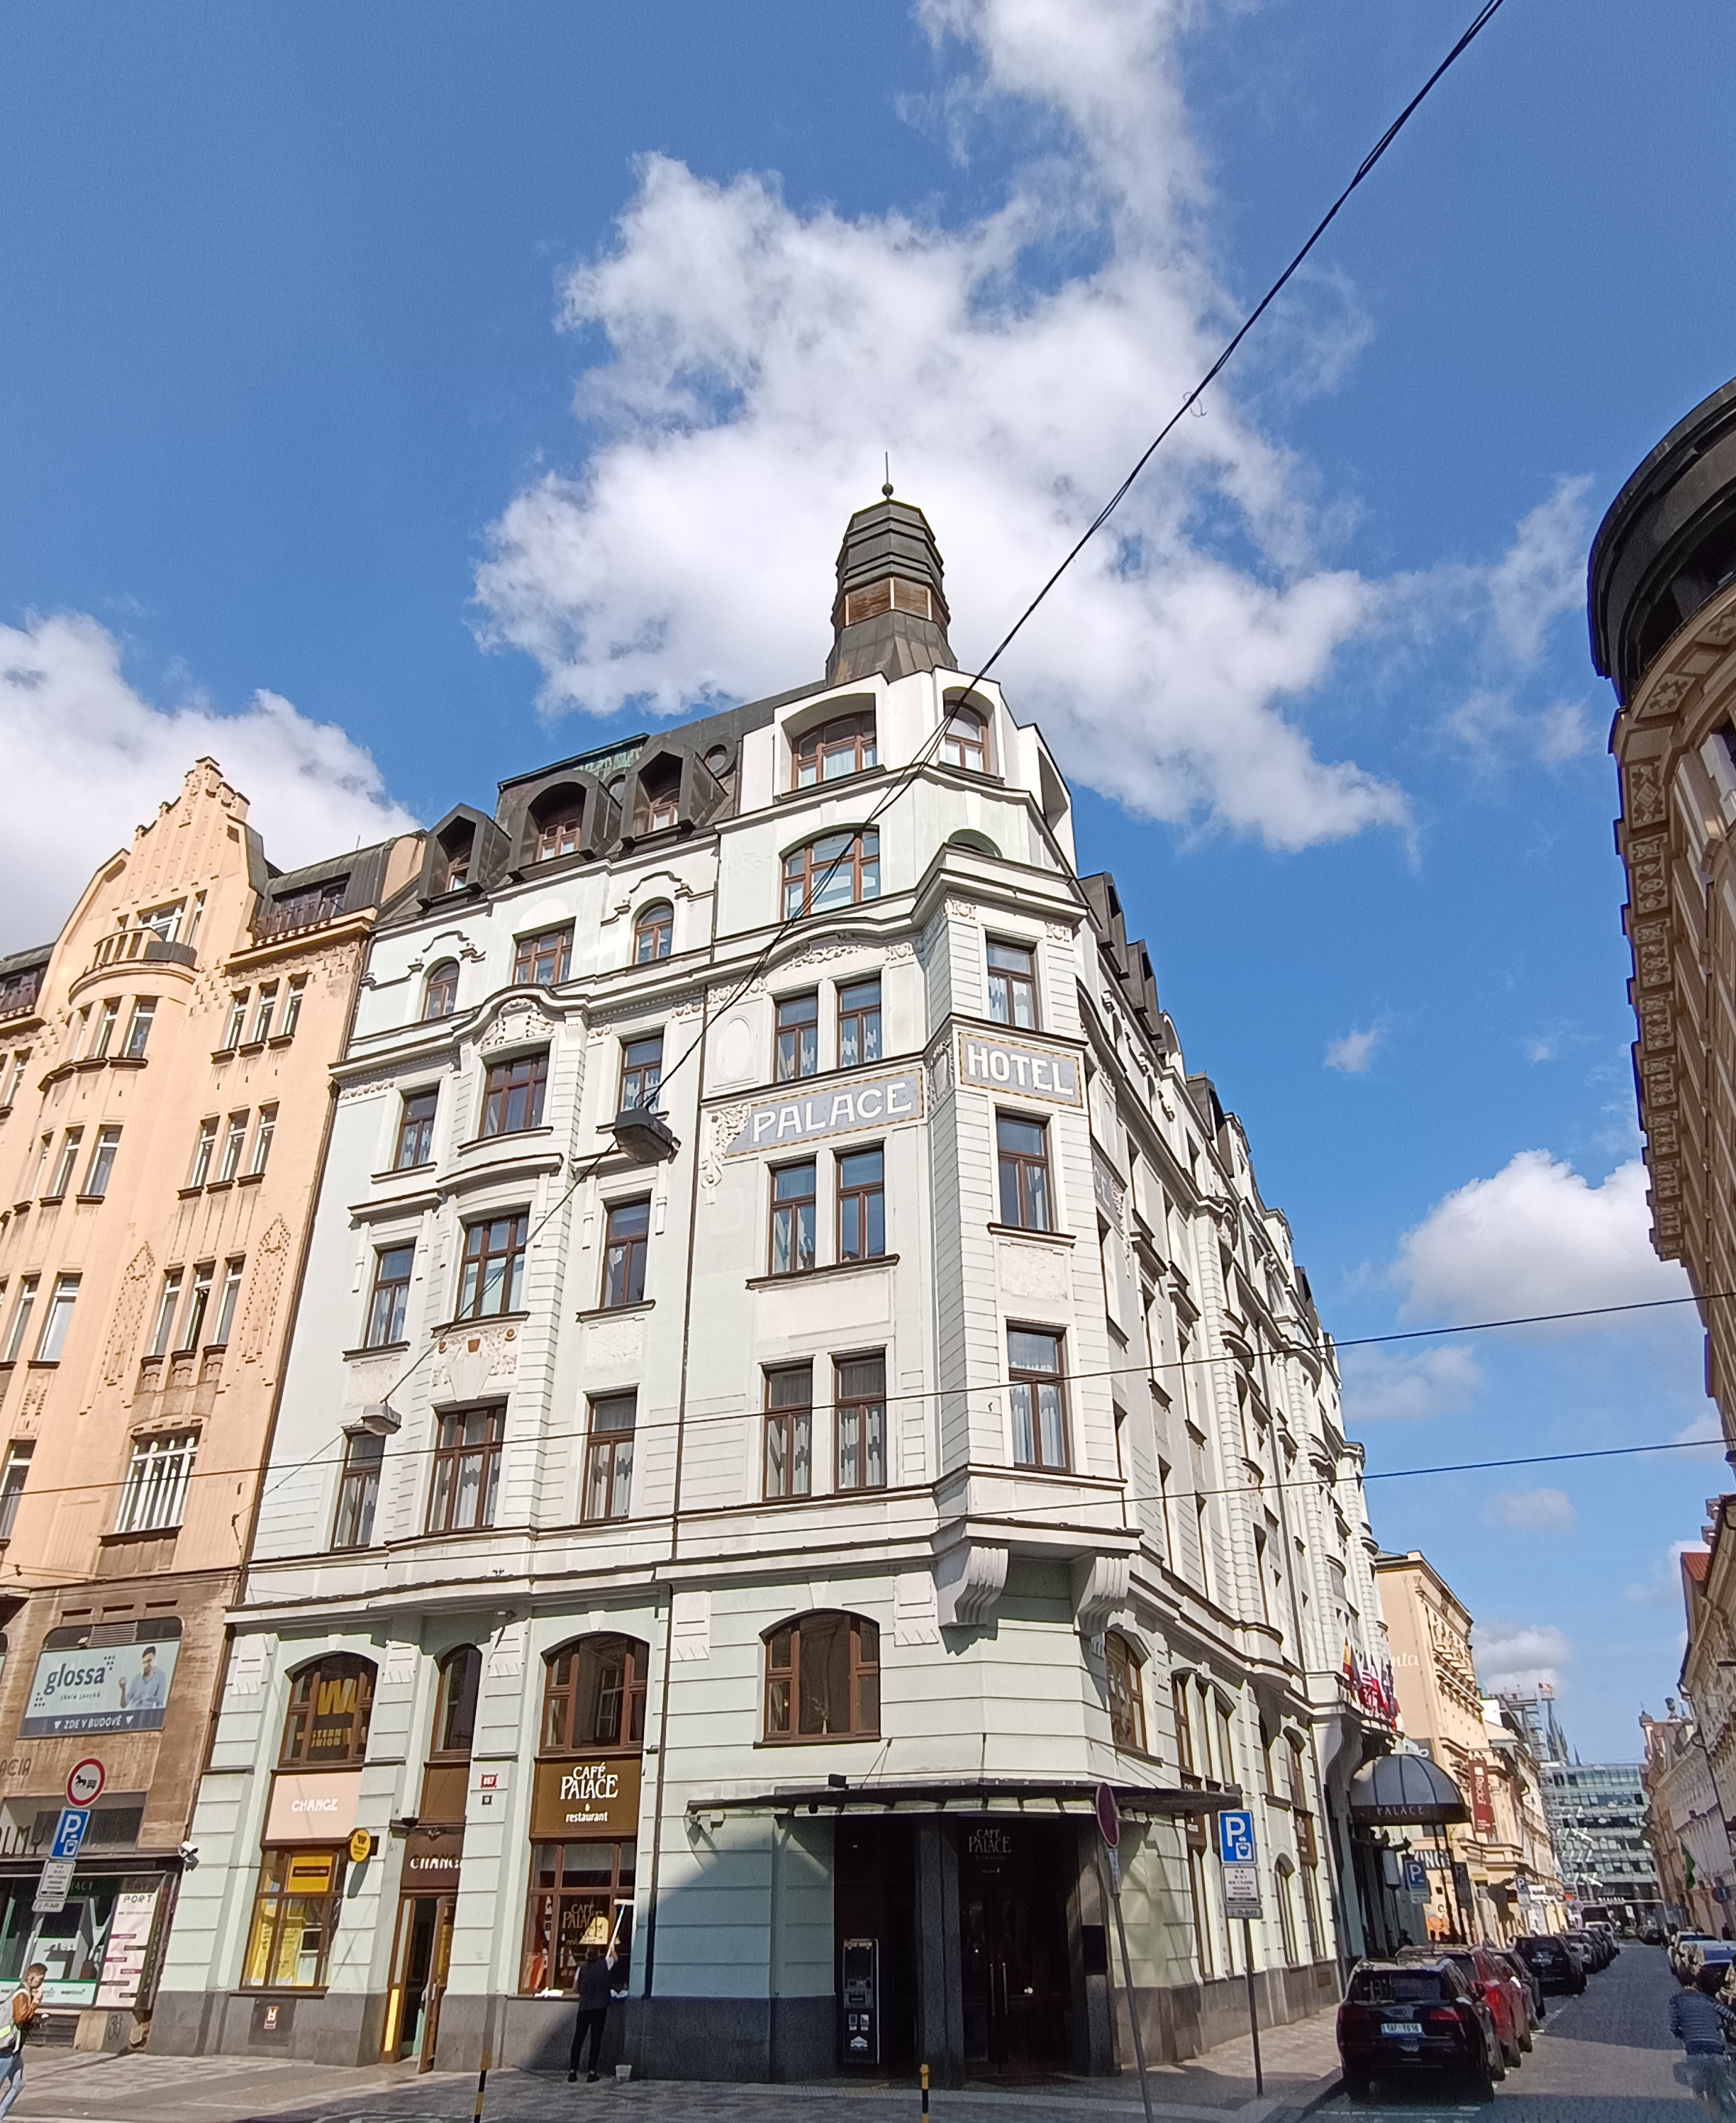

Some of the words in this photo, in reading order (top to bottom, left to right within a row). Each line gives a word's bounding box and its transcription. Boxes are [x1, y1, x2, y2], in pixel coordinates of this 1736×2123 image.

[967, 1044, 1074, 1096] HOTEL
[752, 1082, 912, 1142] PALACE
[43, 1663, 106, 1695] glossa
[63, 1719, 80, 1729] ZDE
[82, 1718, 87, 1728] V
[572, 1761, 606, 1780] CAFÉ
[560, 1774, 619, 1800] PALACE
[291, 1798, 339, 1812] CHANGE
[1376, 1805, 1425, 1817] PALACE
[565, 1811, 608, 1823] restaurant
[60, 1815, 82, 1844] P
[1225, 1817, 1246, 1847] P
[969, 1836, 1012, 1854] PALACE
[410, 1855, 461, 1869] CHANG
[1409, 1864, 1421, 1882] P
[72, 1880, 94, 1891] ACY
